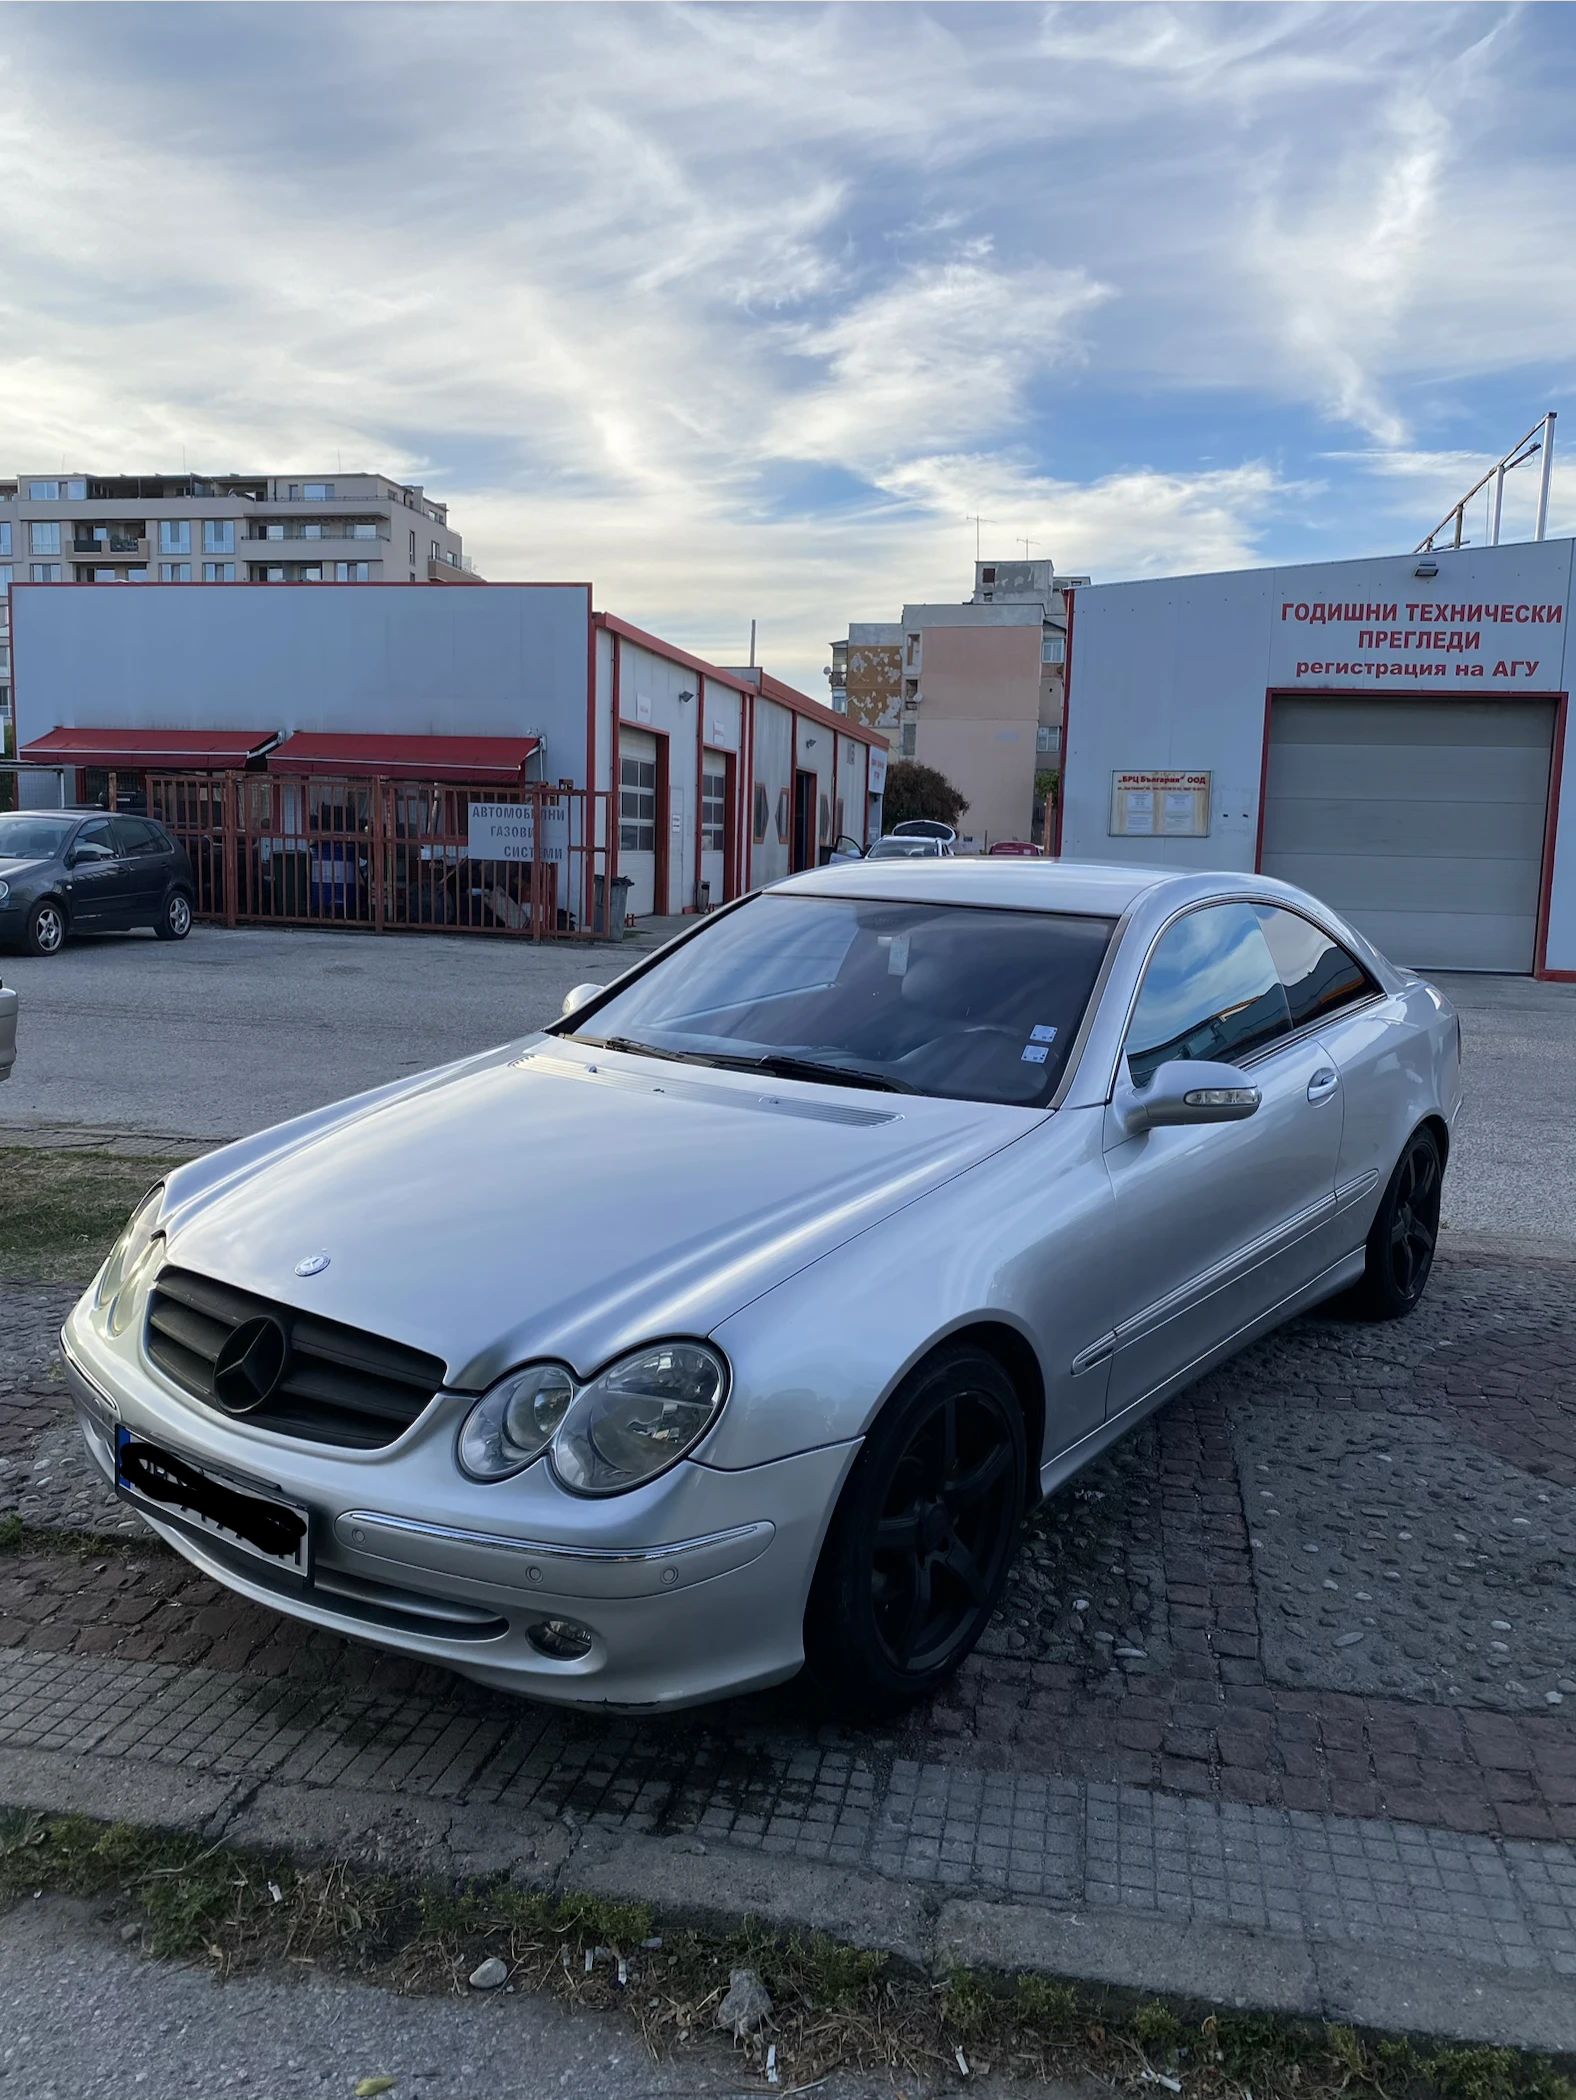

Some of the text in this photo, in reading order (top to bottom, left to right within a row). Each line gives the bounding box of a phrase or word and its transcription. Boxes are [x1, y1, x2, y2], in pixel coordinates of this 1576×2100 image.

[1281, 603, 1563, 624] ГОДИШНИ ТЕХНИЧЕСКИ
[1358, 631, 1481, 653] ПРЕГЛЕДИ
[1296, 661, 1540, 678] регистрация на АГУ
[504, 846, 562, 860] СИСТМИ
